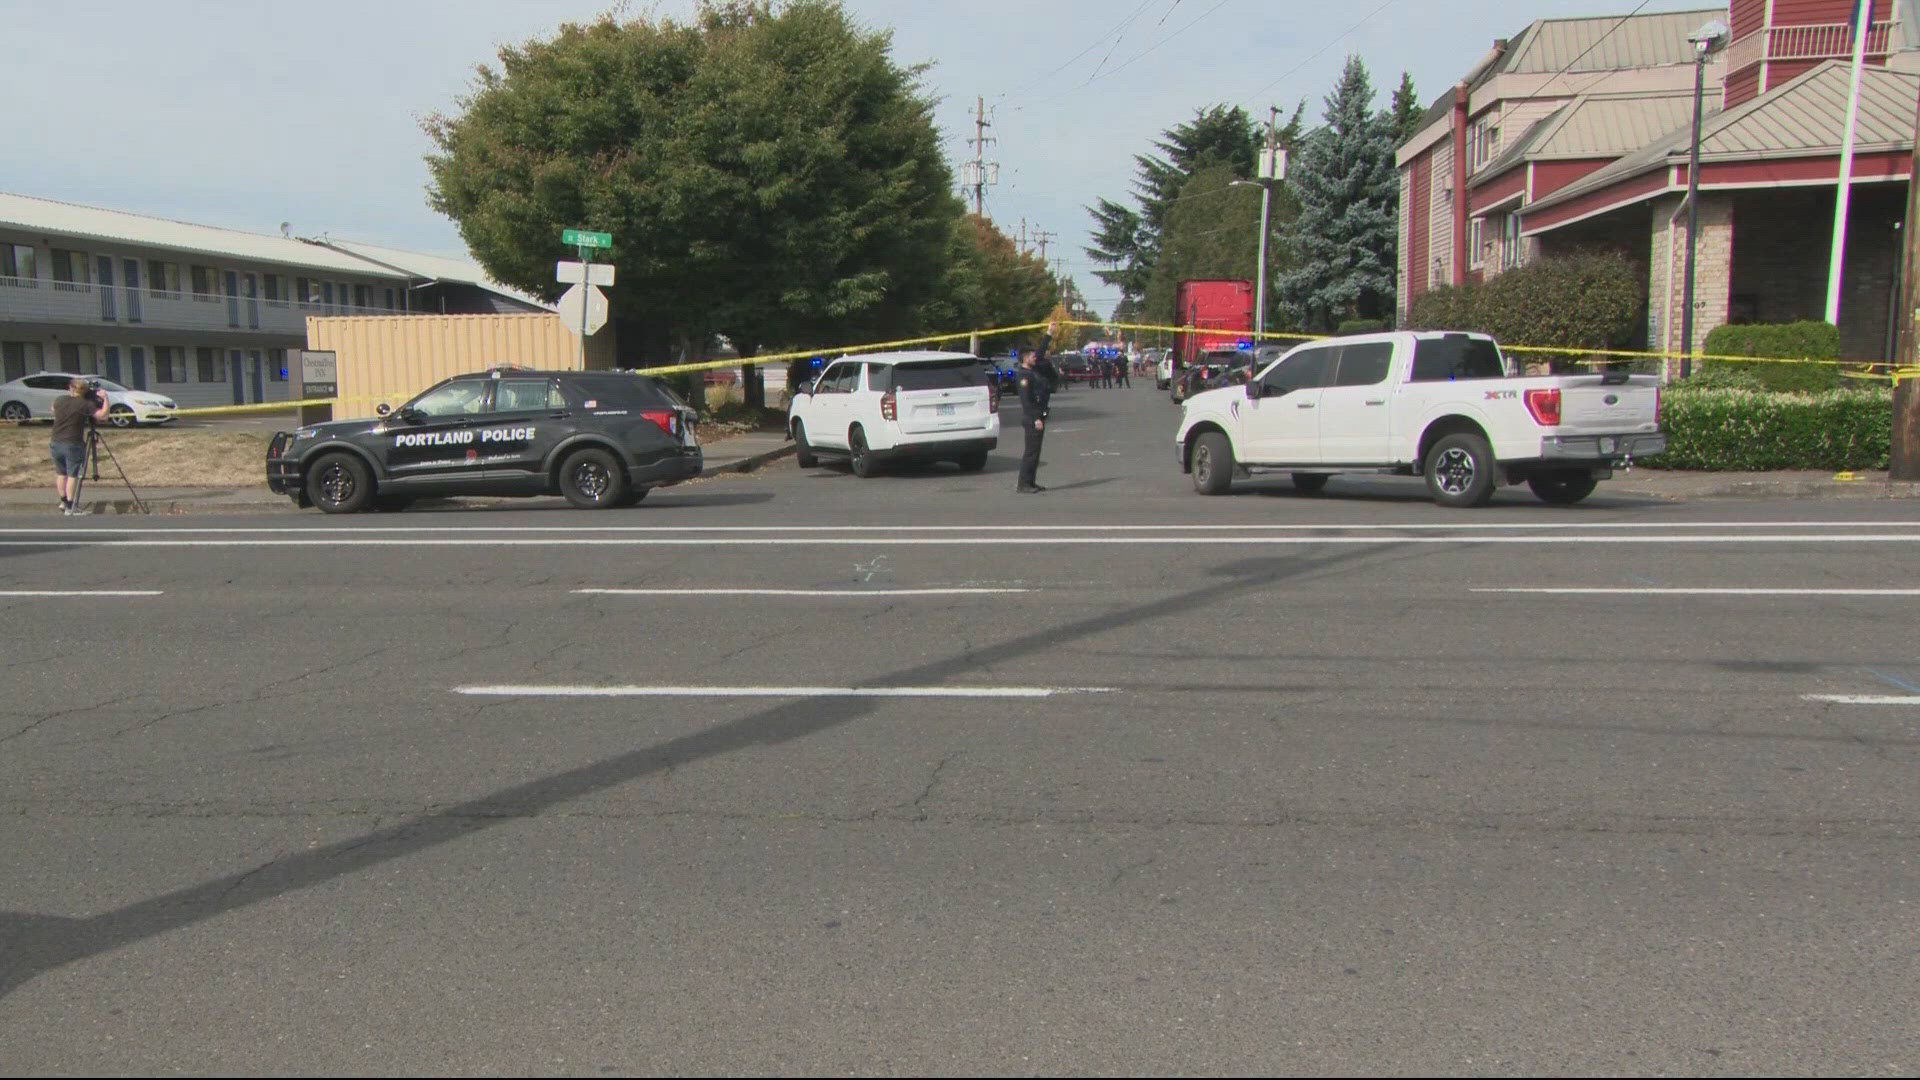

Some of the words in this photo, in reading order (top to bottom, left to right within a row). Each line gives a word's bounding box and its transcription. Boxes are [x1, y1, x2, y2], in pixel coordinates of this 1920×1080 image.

[577, 233, 598, 244] Stark
[395, 431, 474, 447] PORTLAND
[482, 427, 536, 442] POLICE
